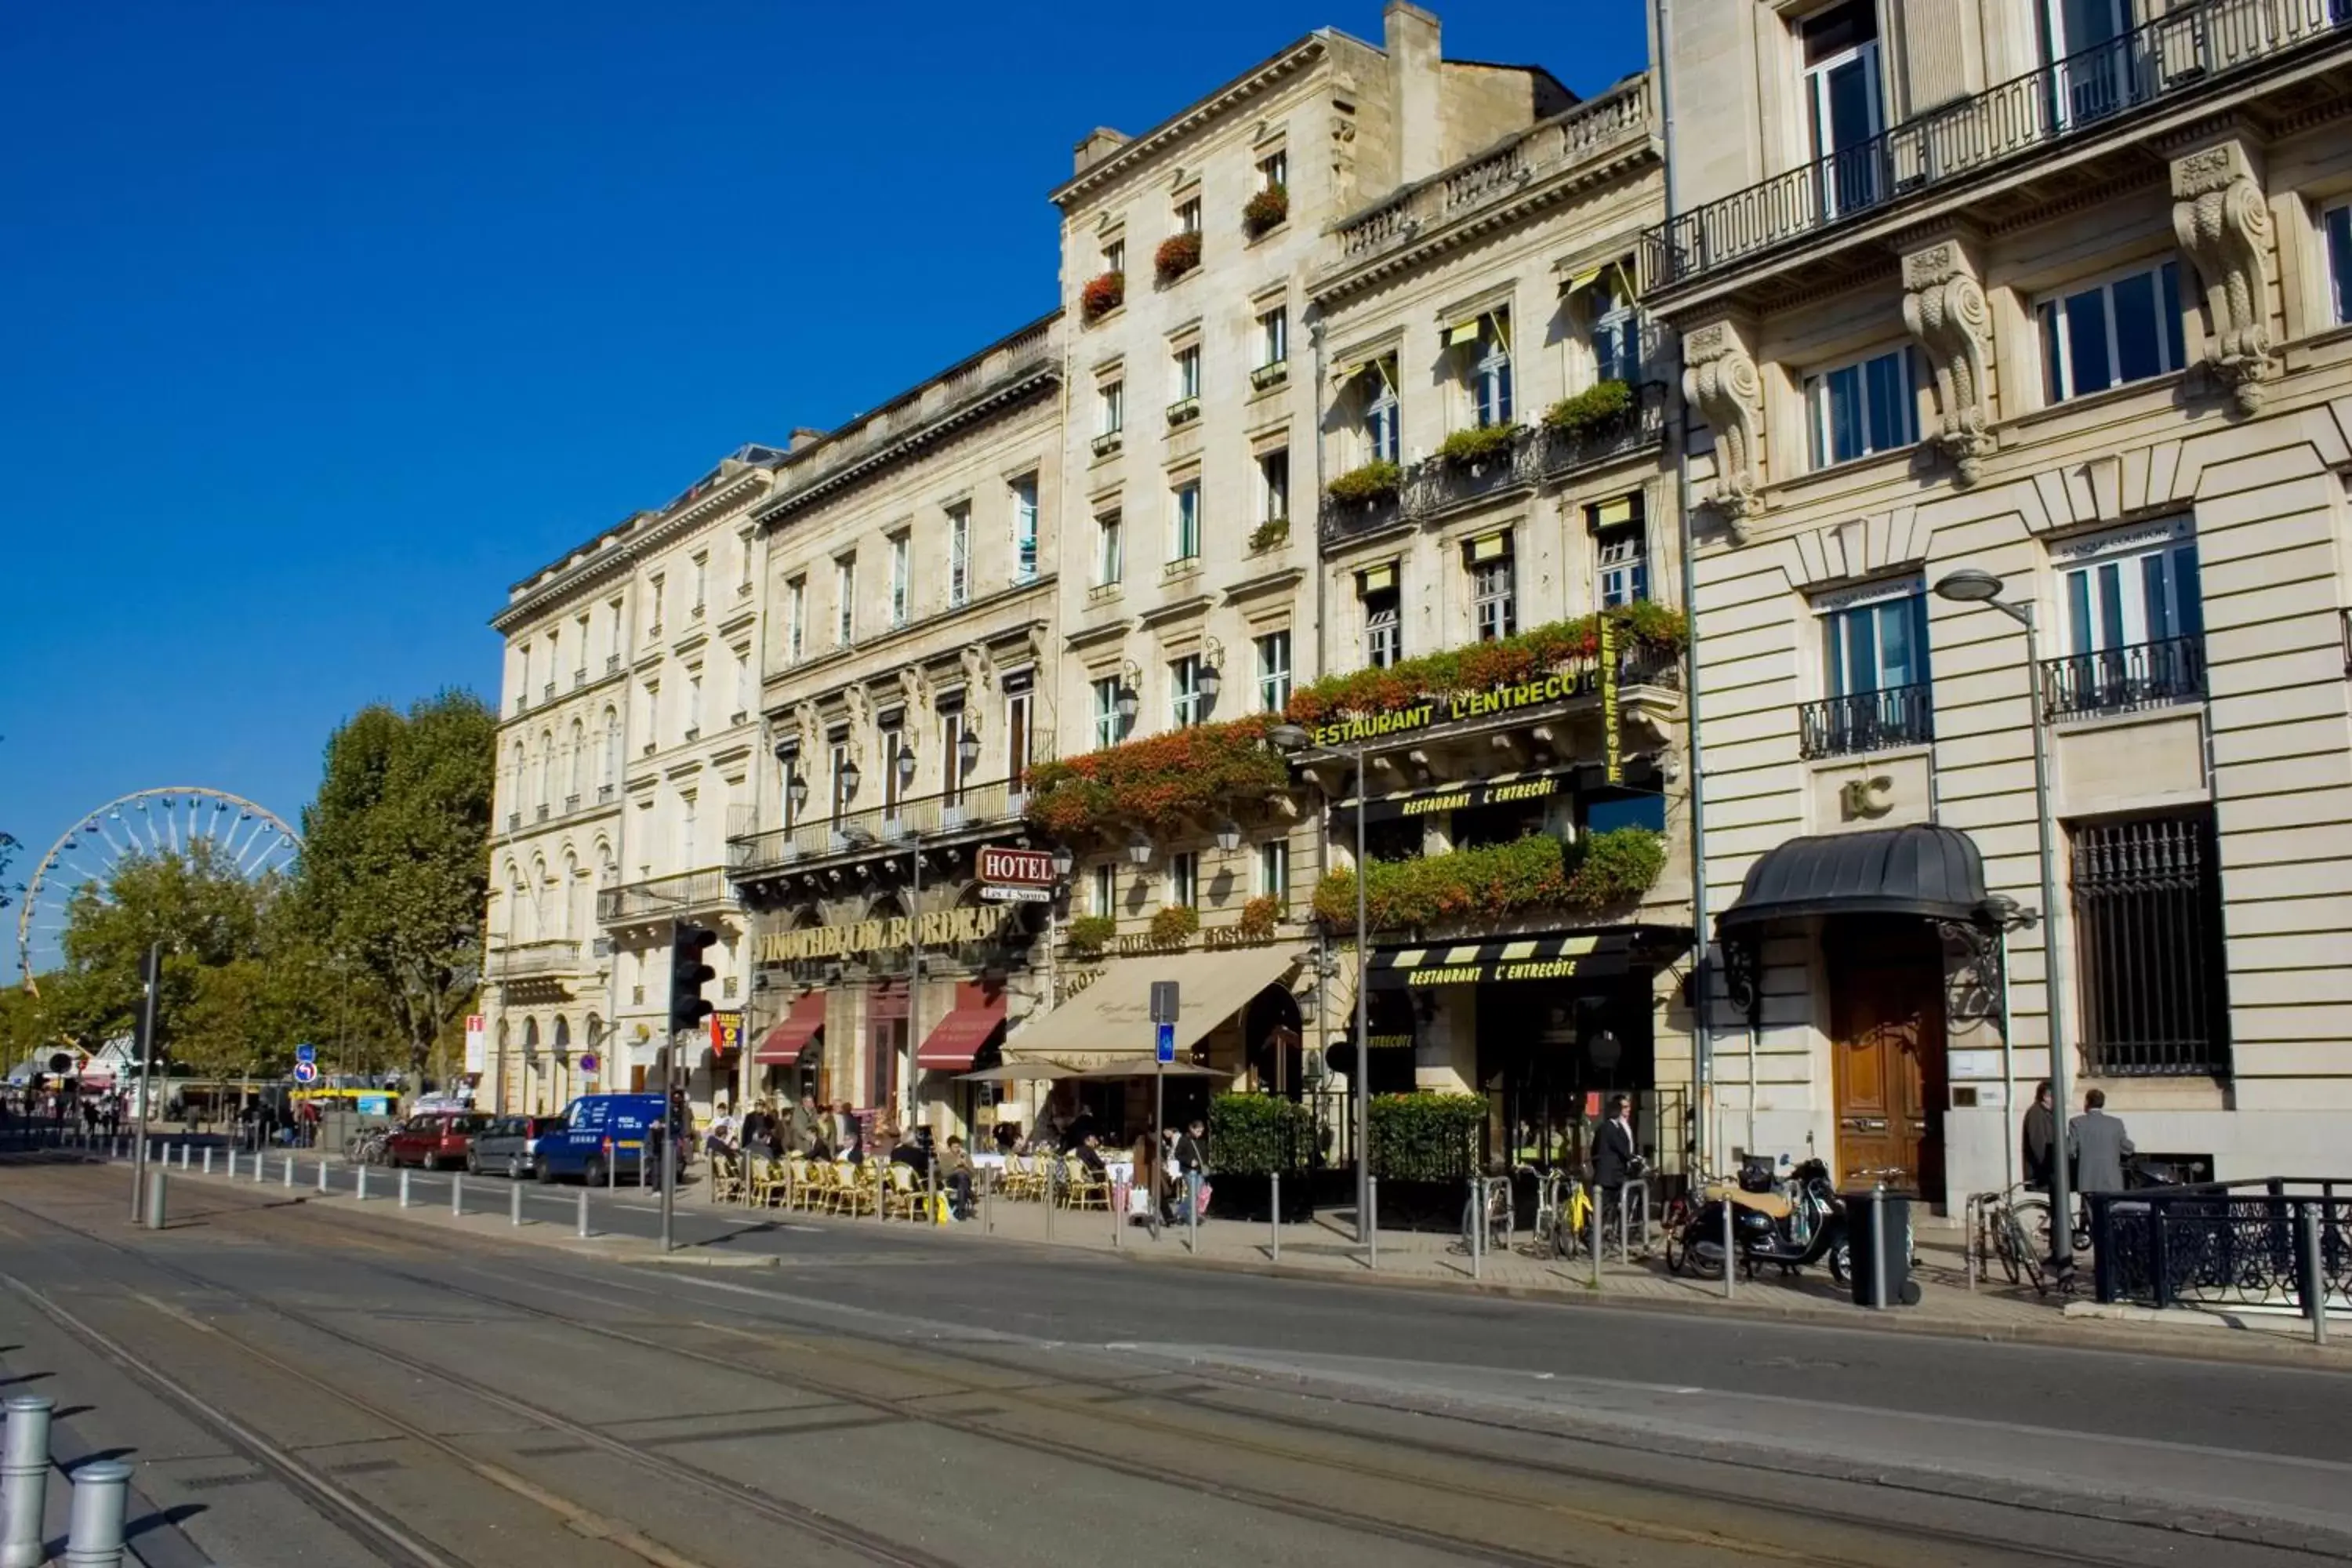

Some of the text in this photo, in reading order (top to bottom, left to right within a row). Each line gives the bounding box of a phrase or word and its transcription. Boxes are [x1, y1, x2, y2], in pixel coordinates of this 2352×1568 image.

[1310, 706, 1433, 745] ESTAURANT
[1402, 793, 1471, 815] RESTAURANT
[985, 854, 1053, 880] HOTEL
[1408, 957, 1577, 985] RESTAURANT L' ENTRECÔTE
